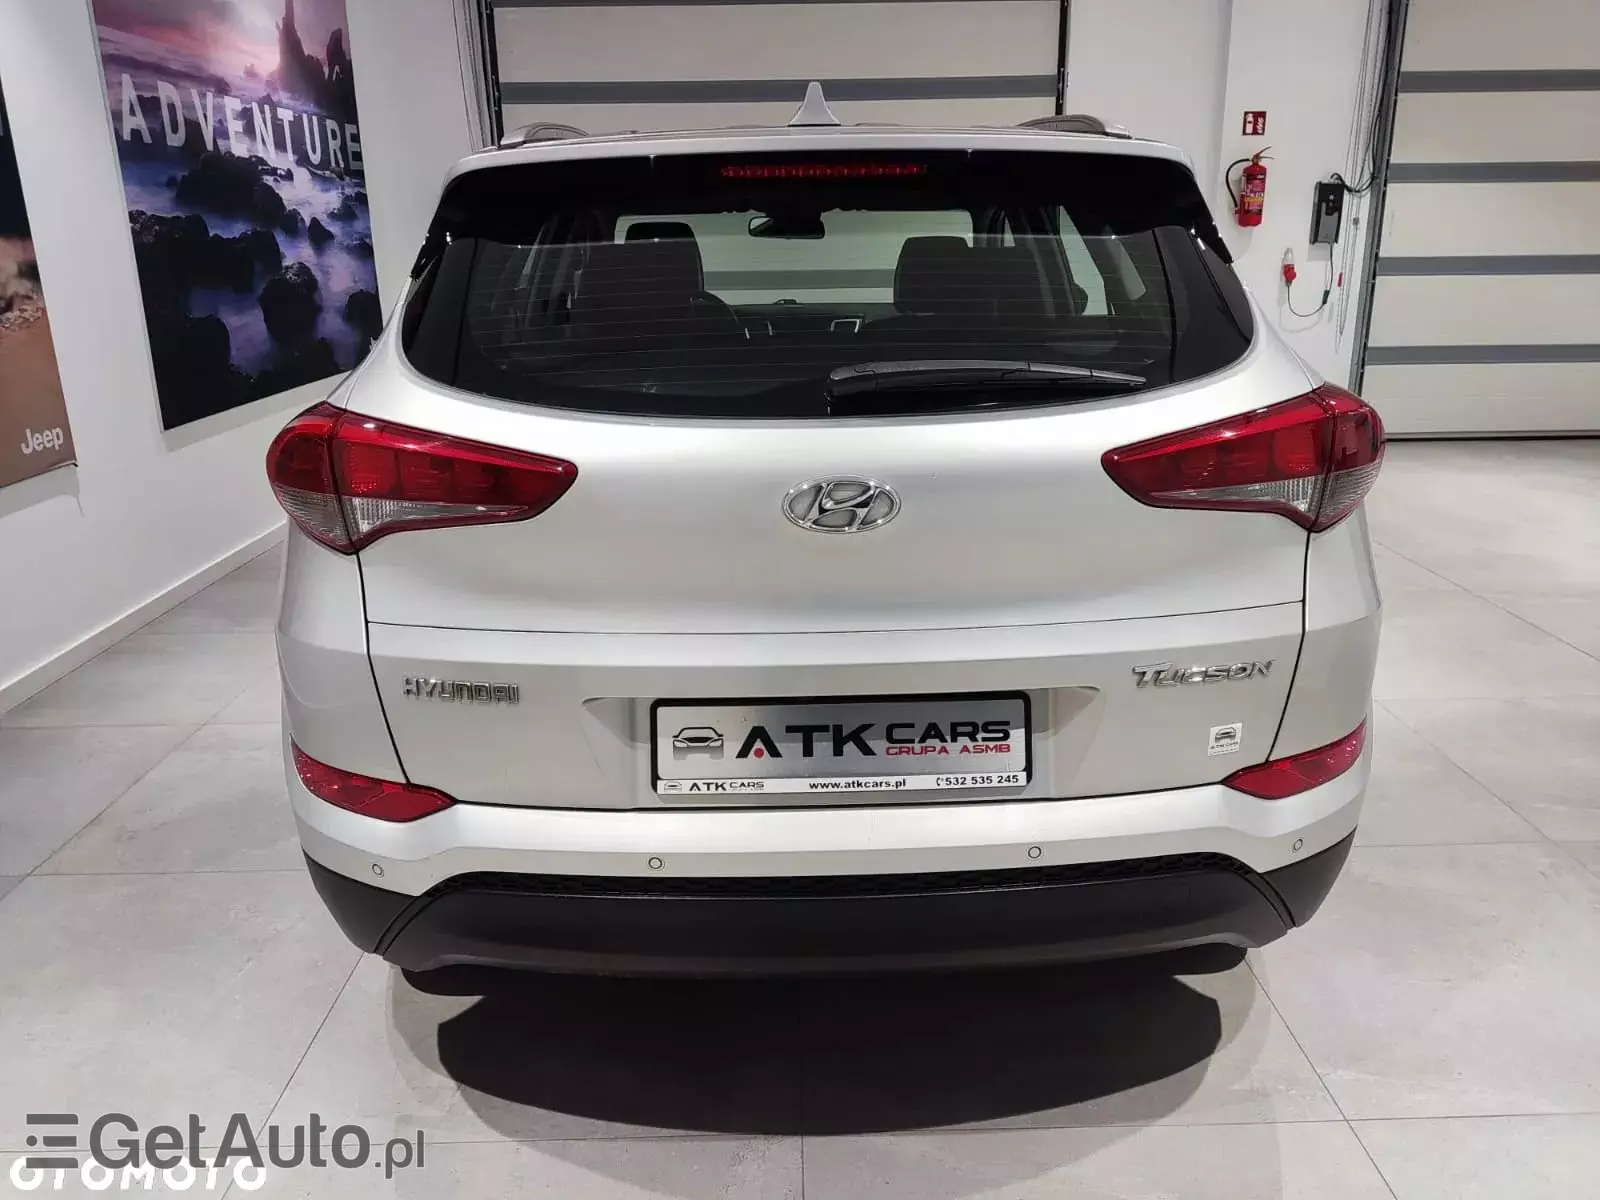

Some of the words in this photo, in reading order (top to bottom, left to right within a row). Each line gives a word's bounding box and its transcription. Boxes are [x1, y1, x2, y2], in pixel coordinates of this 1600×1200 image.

[121, 73, 364, 170] ADVENTURE
[21, 425, 64, 455] Jeep
[1132, 659, 1276, 689] TUCSON
[403, 676, 520, 705] HYUNDAI
[736, 724, 876, 759] ATK
[887, 721, 1010, 744] CARS
[887, 745, 949, 756] GRUPA
[961, 744, 1010, 754] ASMB
[689, 782, 727, 792] ATK
[729, 781, 765, 789] CARS
[809, 779, 906, 791] www.atkcars.pl
[945, 777, 967, 786] 532
[971, 776, 993, 785] 535
[997, 775, 1019, 784] 245
